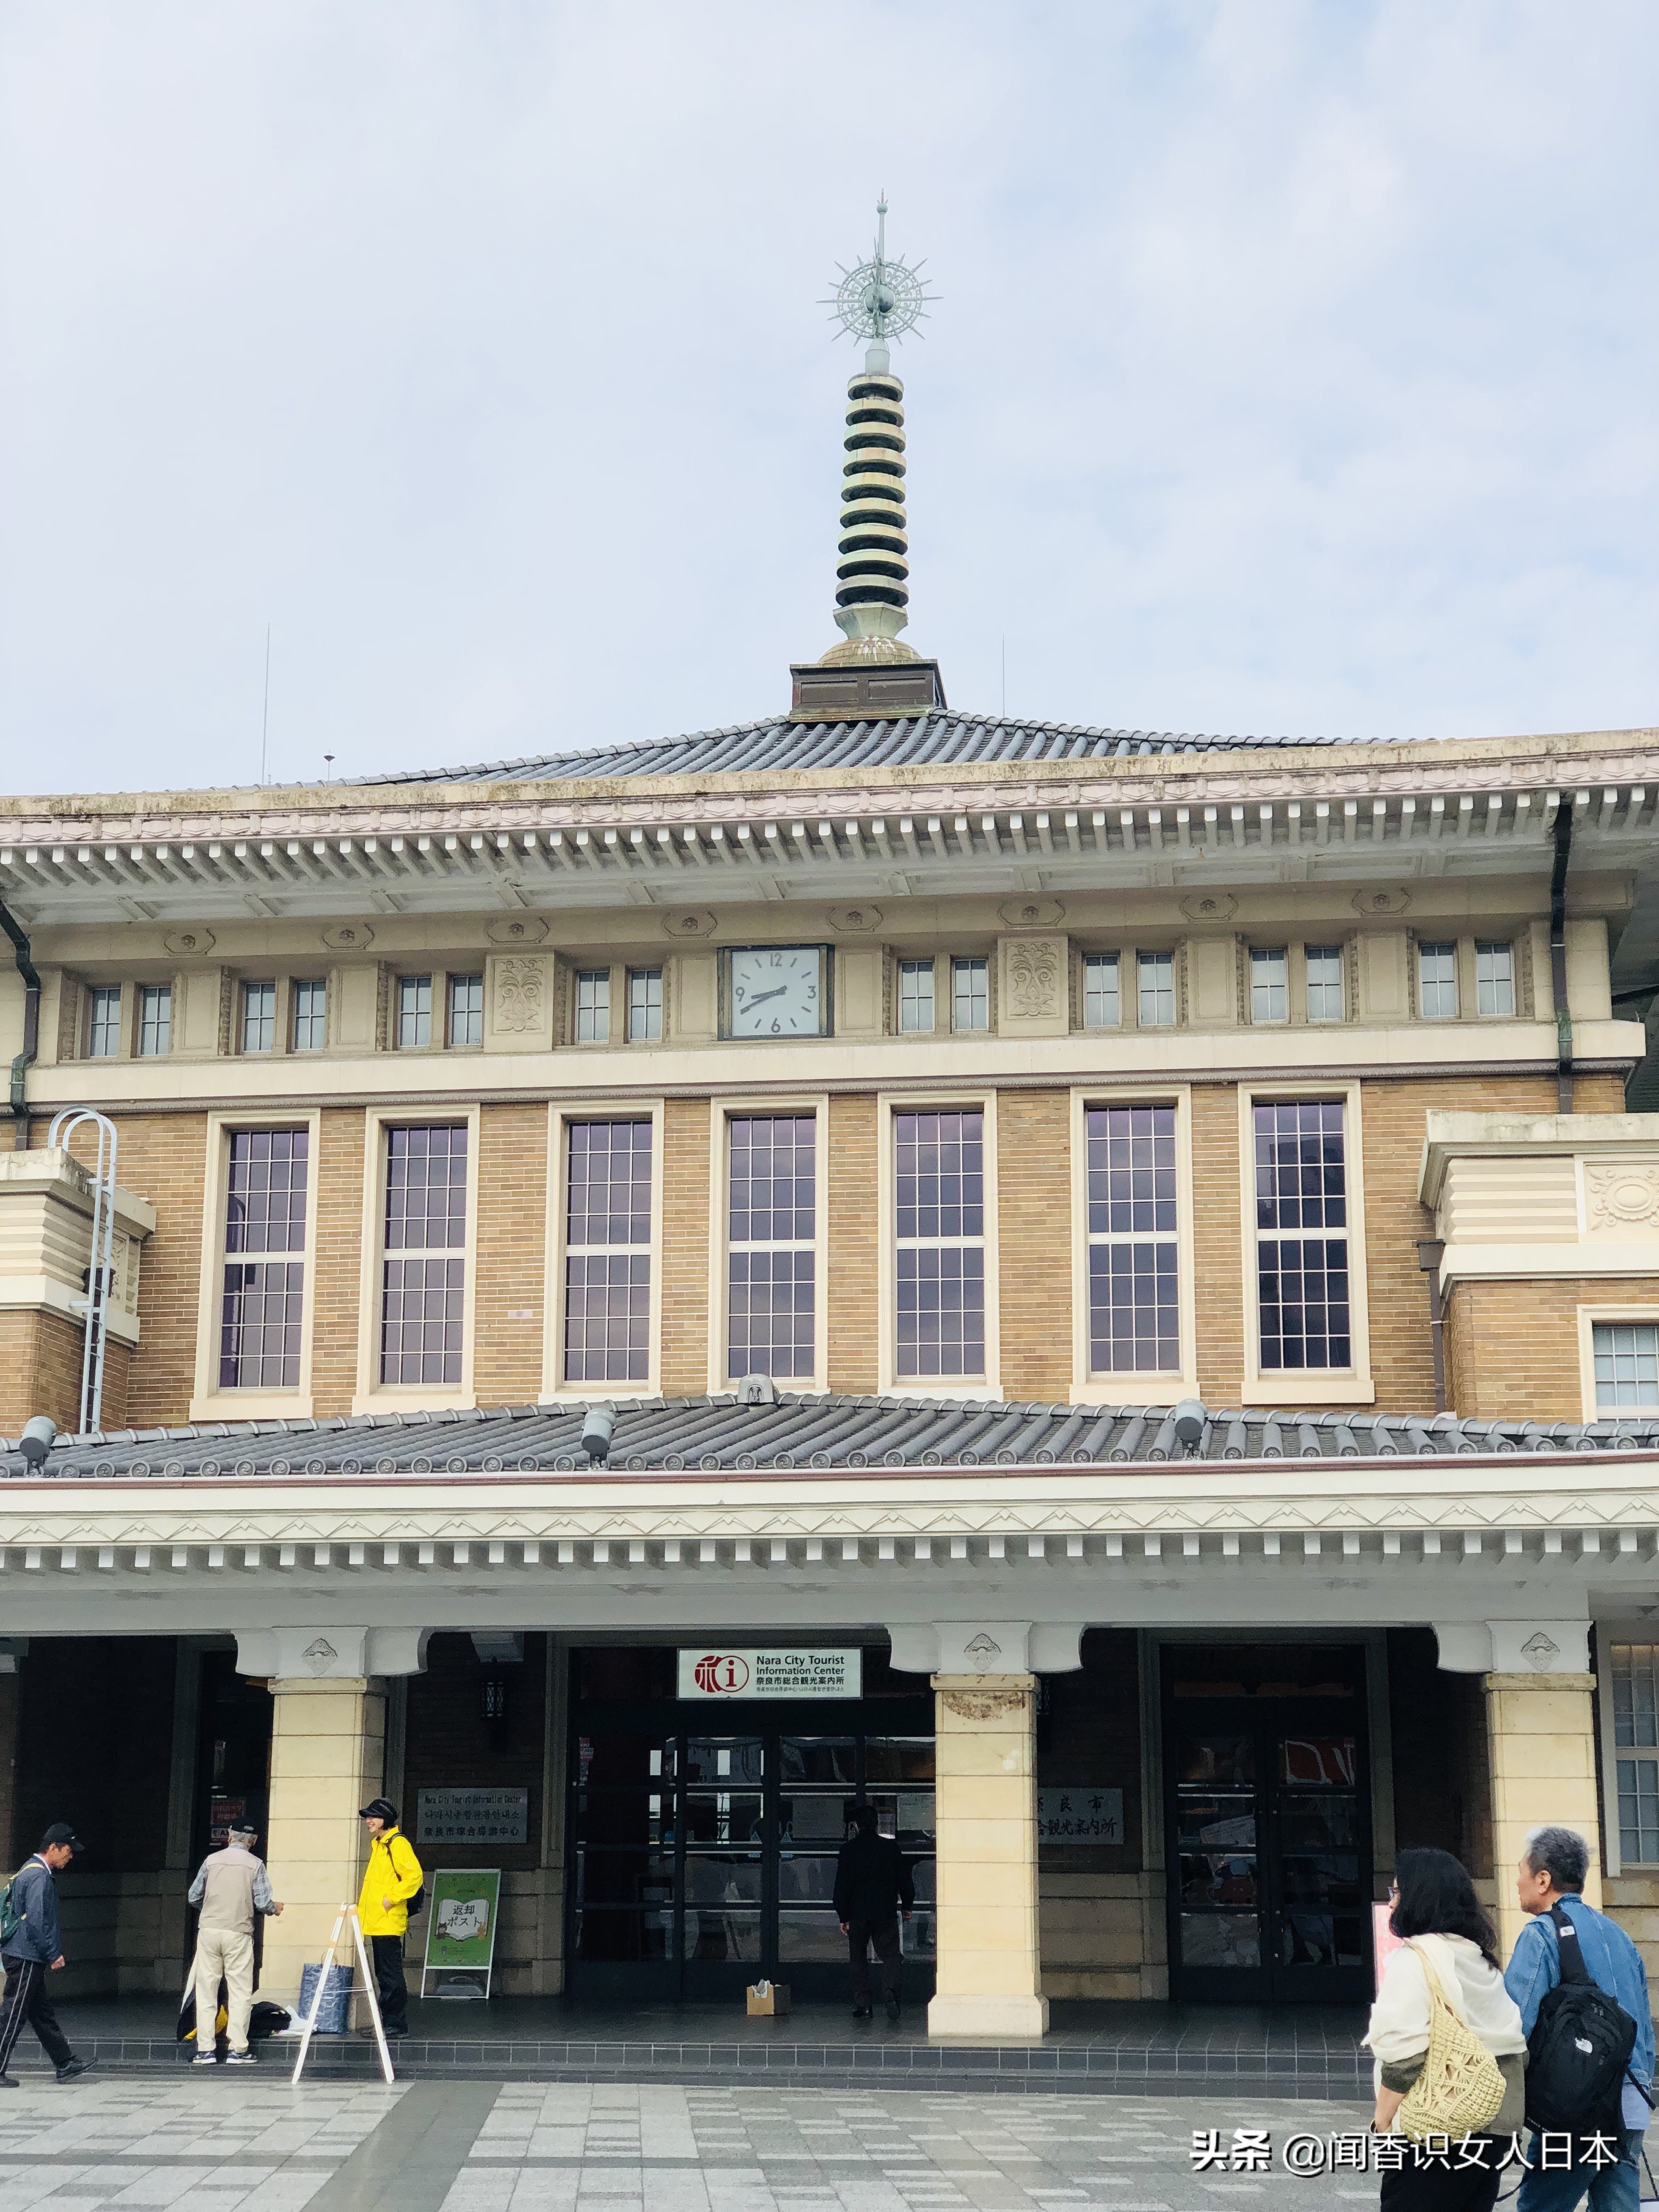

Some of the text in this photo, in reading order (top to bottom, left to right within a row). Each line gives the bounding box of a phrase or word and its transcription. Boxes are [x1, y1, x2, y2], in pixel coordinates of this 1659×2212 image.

[770, 952, 782, 967] 12
[735, 986, 745, 1002] 9
[808, 986, 816, 999] 3
[771, 1017, 781, 1032] 6
[757, 1655, 844, 1667] Nara City Tourist
[757, 1667, 844, 1675] Information Center
[756, 1677, 844, 1685] 奈良市総合観光案内所
[504, 1795, 521, 1804] Center
[453, 1904, 475, 1916] 返却
[447, 1916, 480, 1927] ポスト
